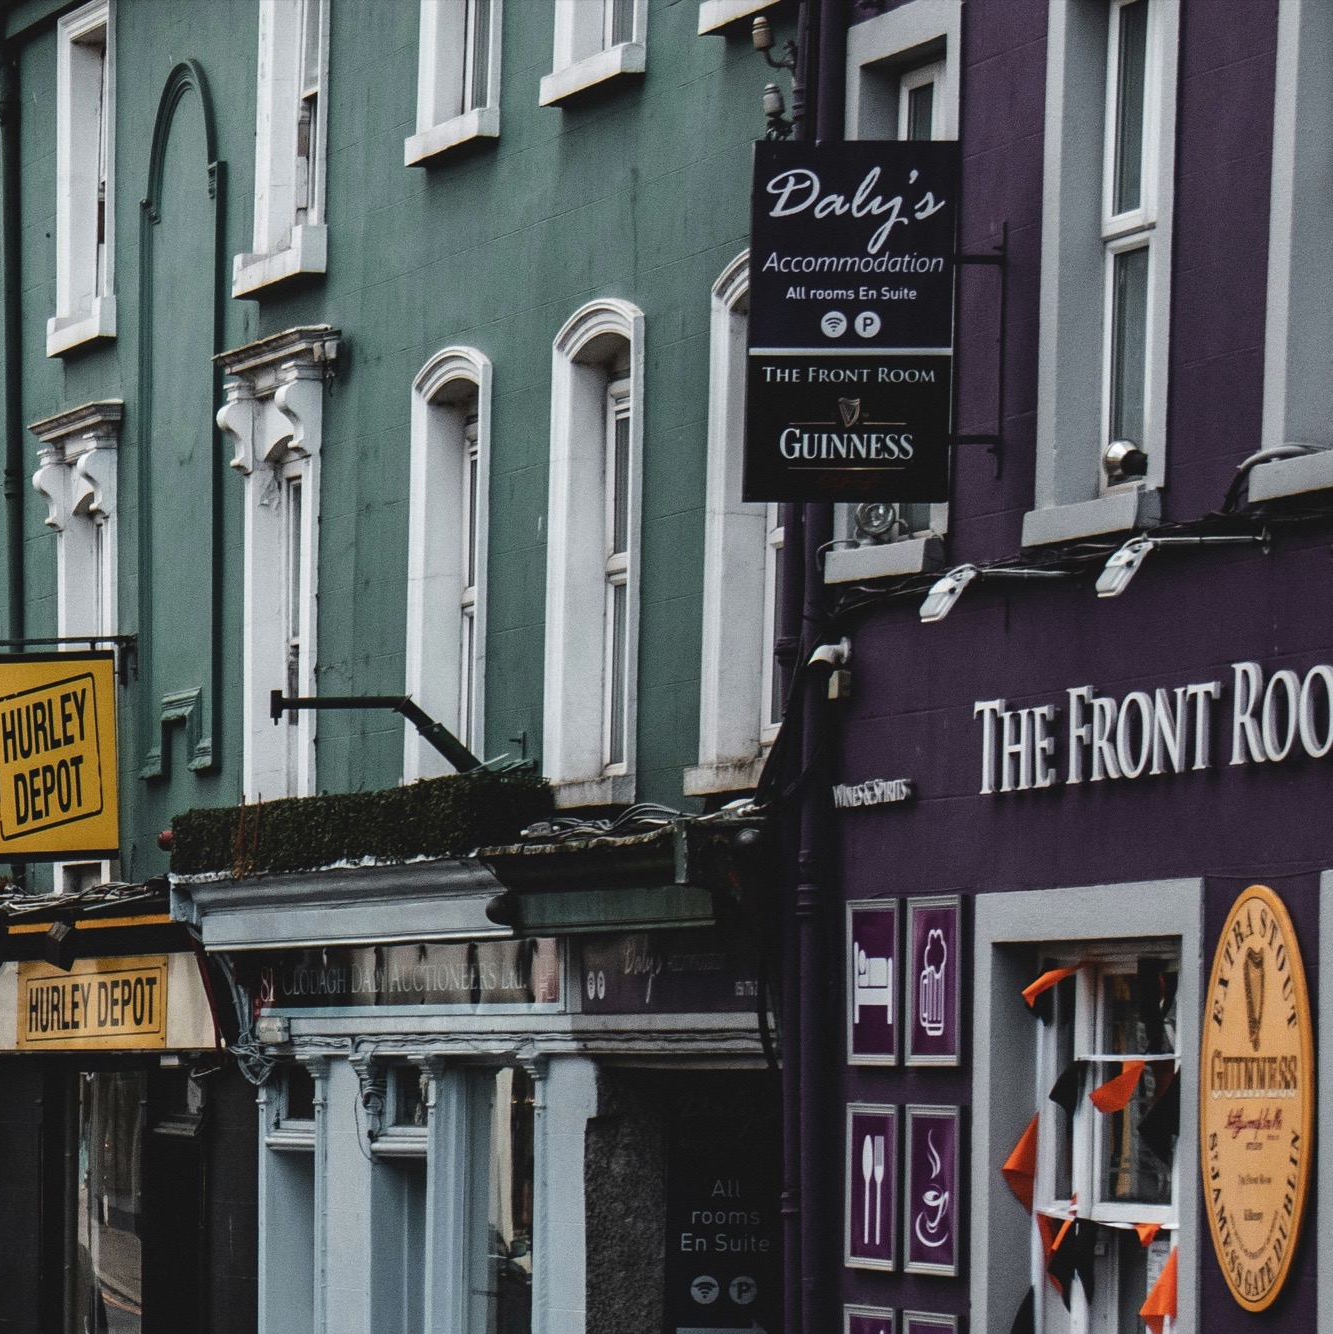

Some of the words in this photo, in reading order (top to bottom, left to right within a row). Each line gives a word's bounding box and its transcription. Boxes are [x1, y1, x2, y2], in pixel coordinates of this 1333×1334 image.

[766, 166, 946, 255] Daly's
[763, 252, 944, 273] Accommodation
[786, 287, 806, 300] All
[810, 288, 855, 300] rooms
[859, 287, 877, 300] En
[881, 287, 917, 300] Suite
[762, 367, 801, 382] THE
[808, 367, 871, 383] FRONT
[877, 368, 935, 383] ROOM
[780, 428, 914, 460] GUINNESS
[1, 688, 87, 764] HURLEY
[974, 698, 1058, 794] THE
[1066, 684, 1221, 785] FRONT
[13, 755, 84, 826] DEPOT
[261, 966, 275, 1002] 81
[283, 967, 347, 996] CLODAGH
[389, 961, 499, 994] AUCTIONEERS
[1213, 906, 1255, 1028] EXTRA
[1259, 906, 1298, 1029] STOUT
[29, 982, 91, 1033] HURLEY
[98, 977, 157, 1028] DEPOT
[1211, 1051, 1298, 1098] GUINNESS
[711, 1179, 740, 1198] All
[1273, 1130, 1300, 1265] DUBLIN
[691, 1211, 760, 1225] rooms
[681, 1233, 707, 1251] En
[715, 1233, 770, 1252] Suite
[1244, 1270, 1274, 1298] GATE
